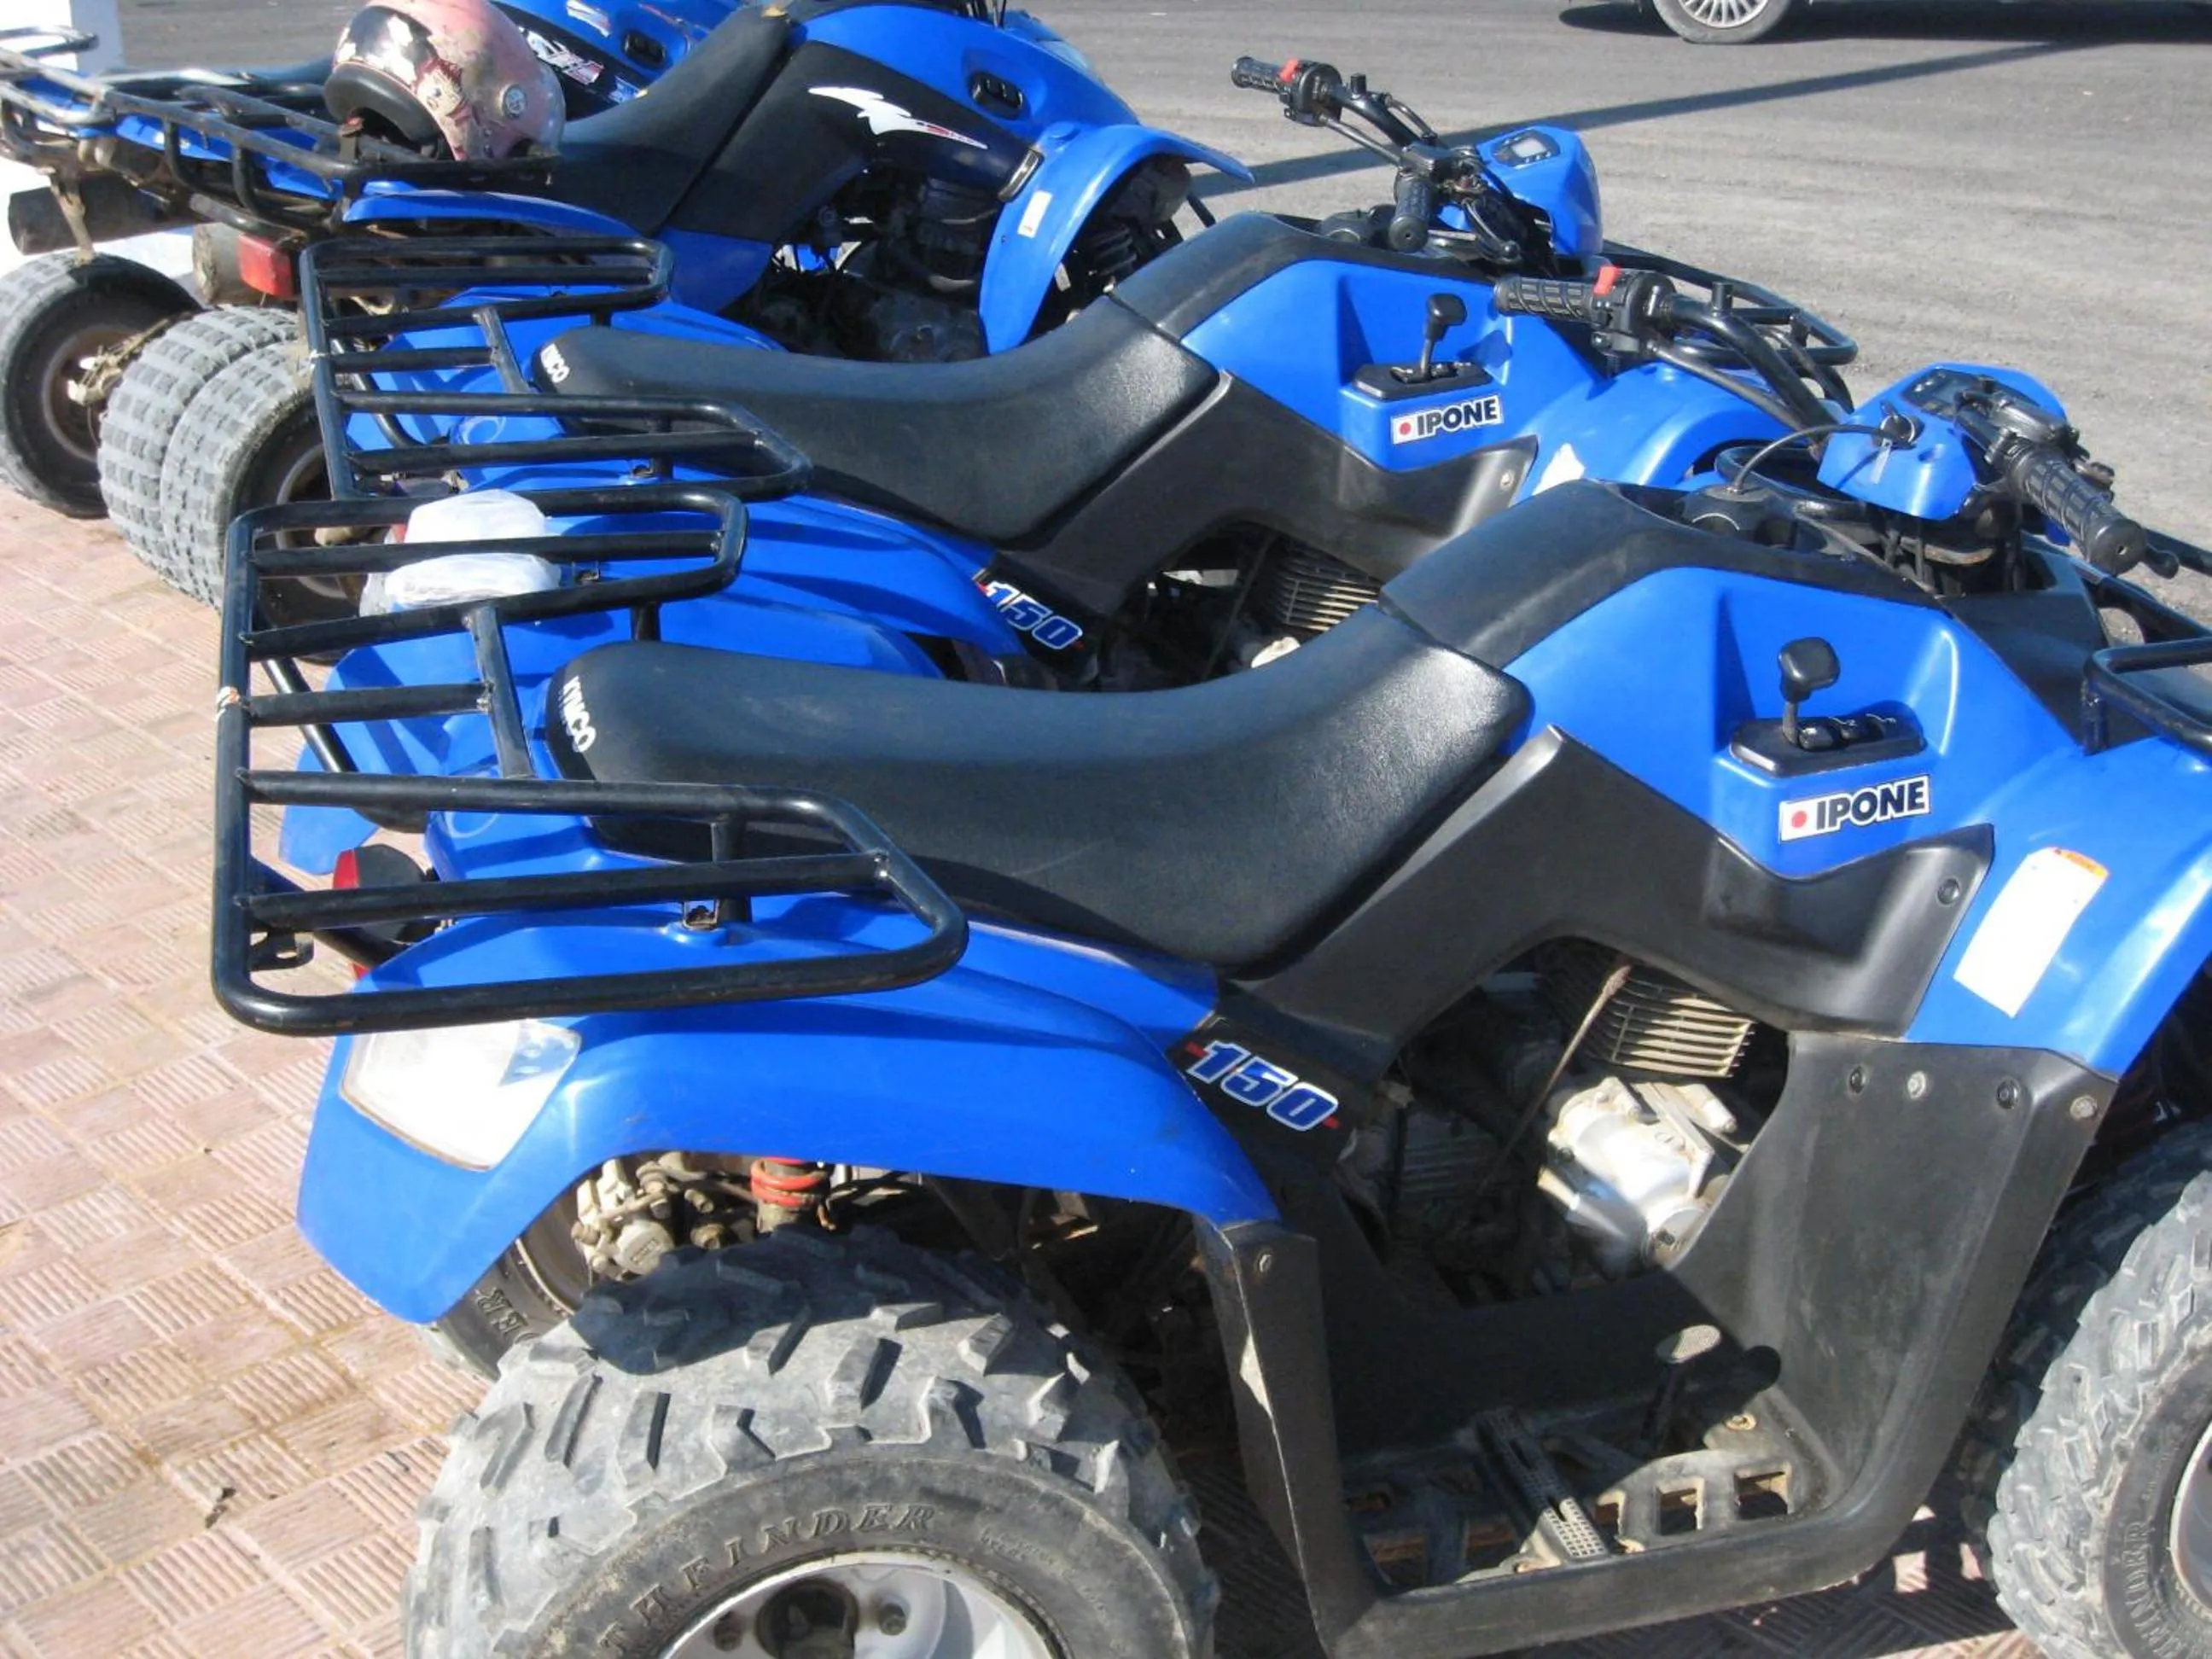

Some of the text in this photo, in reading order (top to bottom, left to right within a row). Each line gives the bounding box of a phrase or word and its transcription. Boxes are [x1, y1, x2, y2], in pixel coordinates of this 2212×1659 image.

[1417, 399, 1499, 436] IPONE
[985, 579, 1084, 650] 150
[1815, 779, 1926, 831] IPONE
[1185, 1039, 1340, 1132] 150
